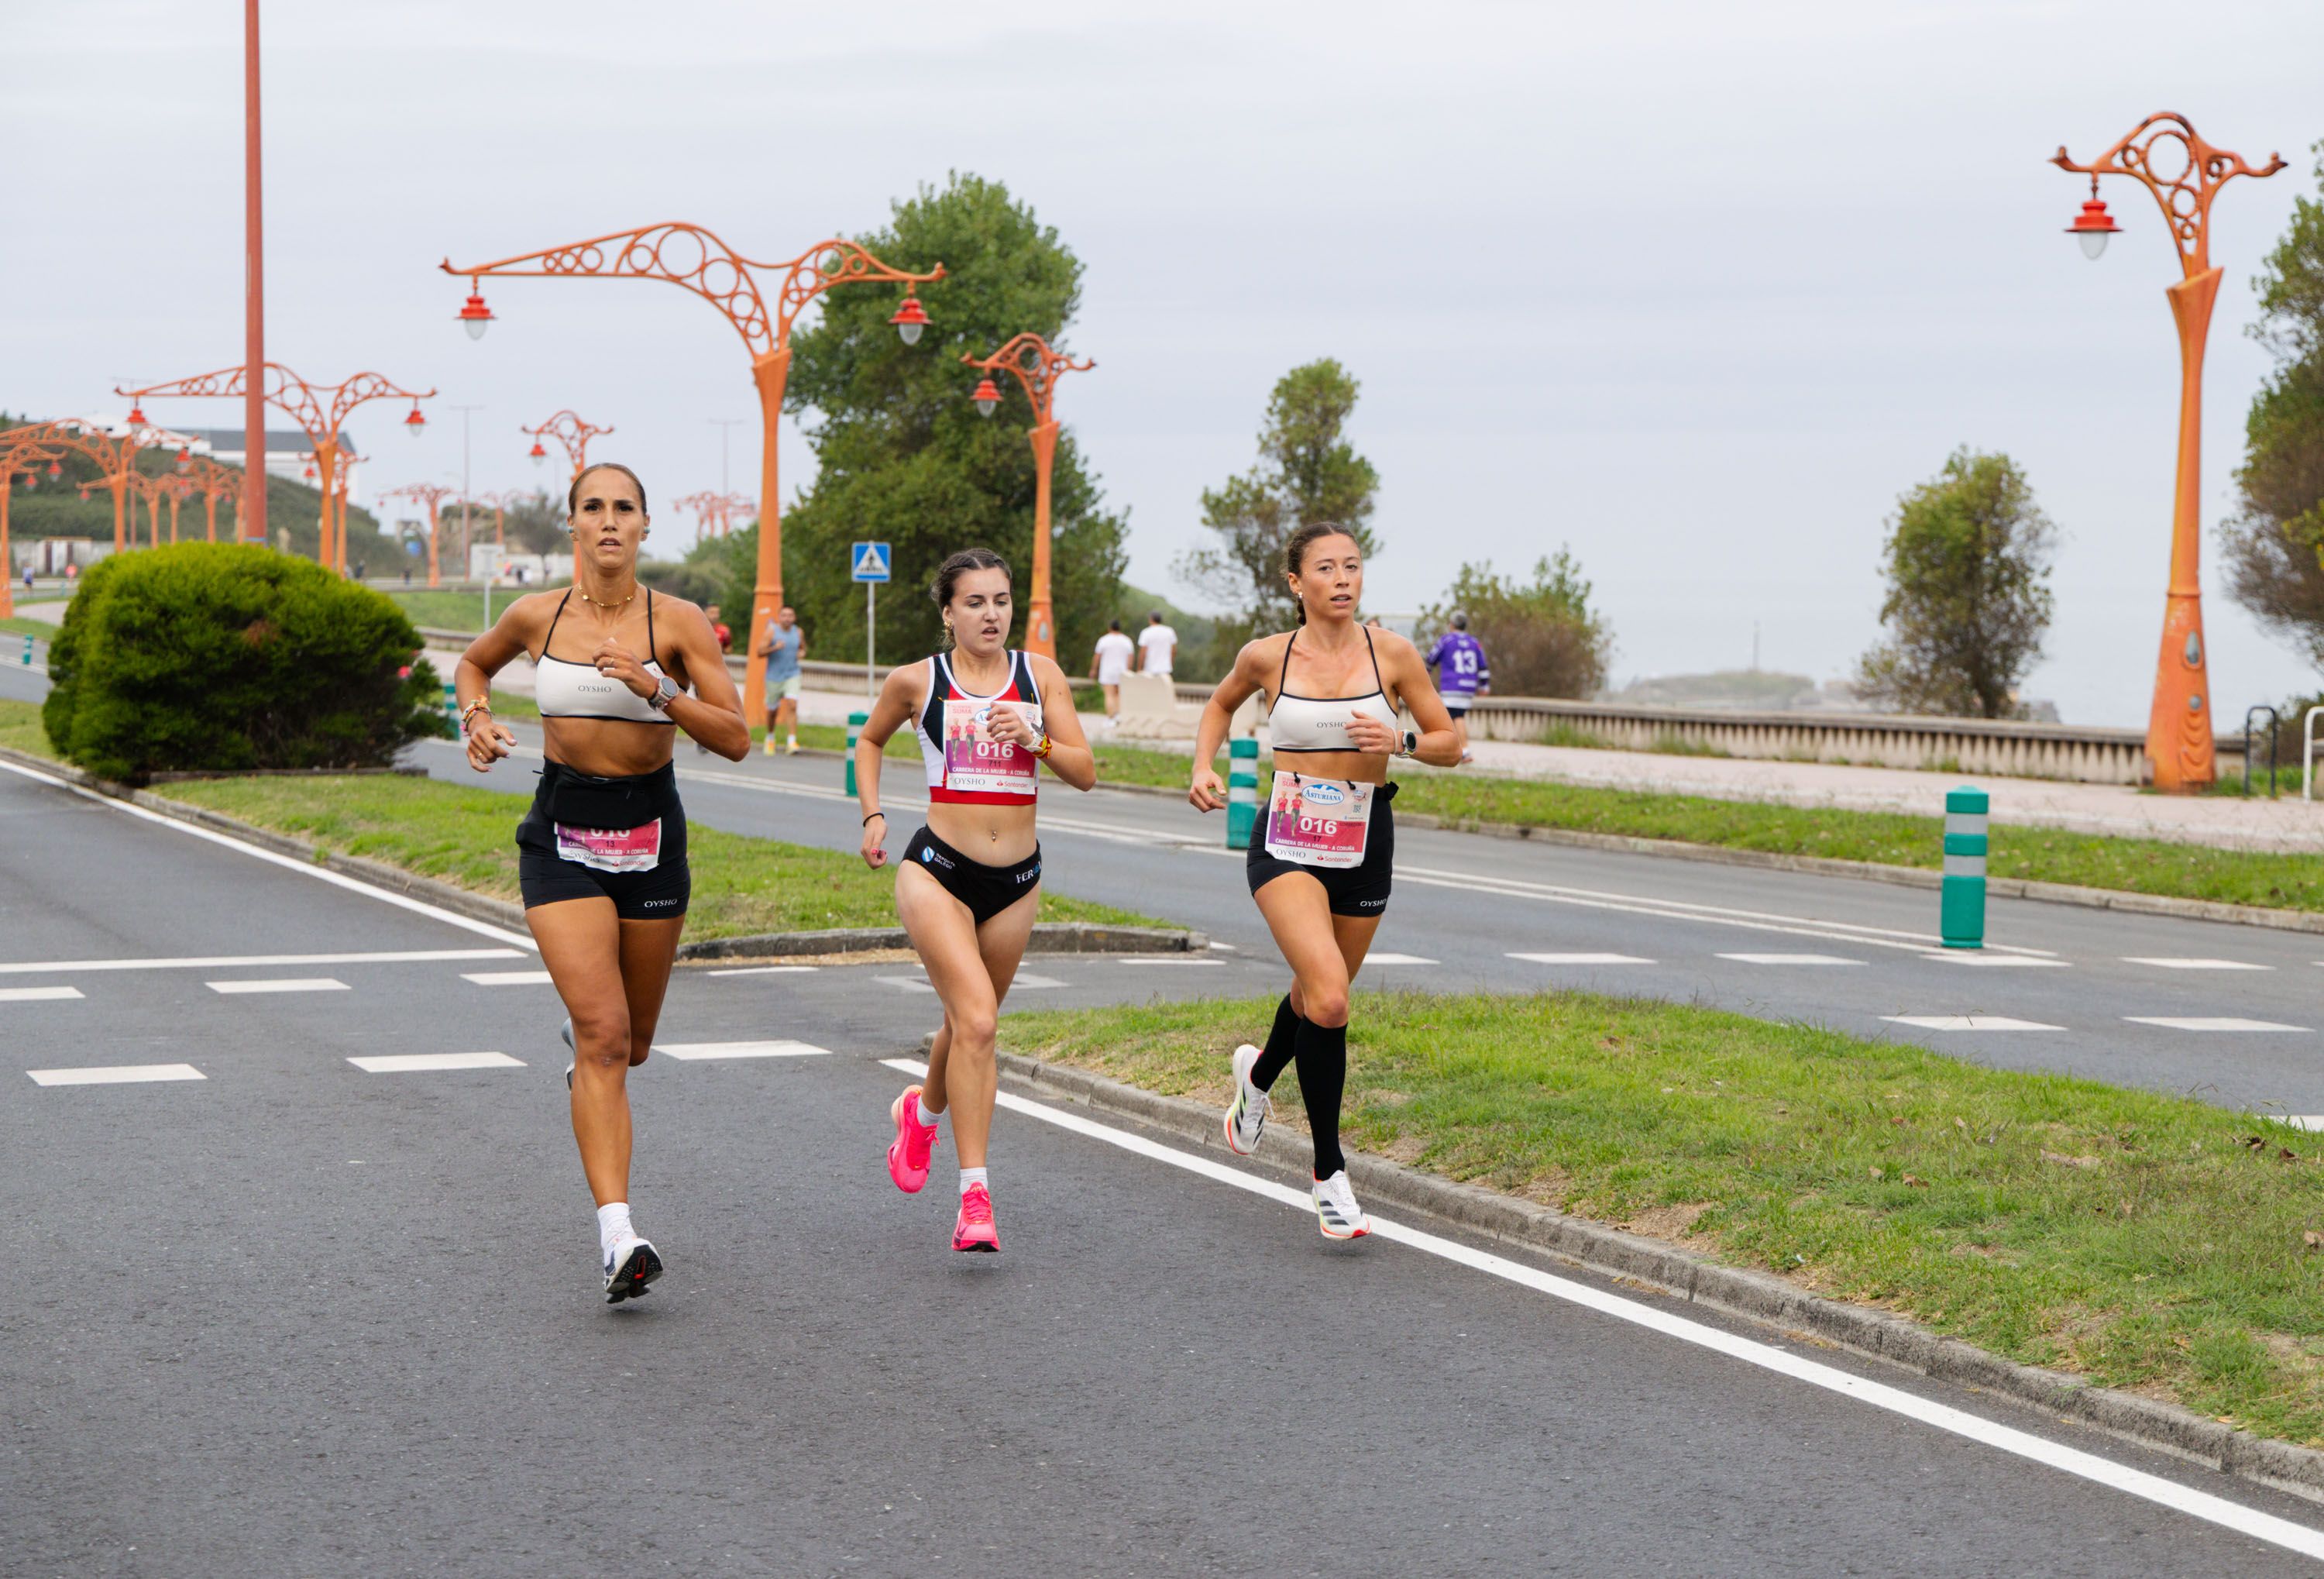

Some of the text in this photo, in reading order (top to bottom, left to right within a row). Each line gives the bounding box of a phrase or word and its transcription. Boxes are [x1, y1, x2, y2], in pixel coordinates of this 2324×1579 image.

[1452, 650, 1477, 674] 13
[976, 741, 1013, 758] 016
[954, 777, 985, 786] OYSHO
[1282, 780, 1301, 789] SUMA
[1305, 790, 1341, 801] ASTURIANA
[1300, 817, 1337, 834] 016
[1276, 848, 1306, 858] OYSHO
[934, 857, 953, 869] GALEGO
[936, 853, 956, 867] DEPORTE
[645, 899, 678, 907] OYSHO
